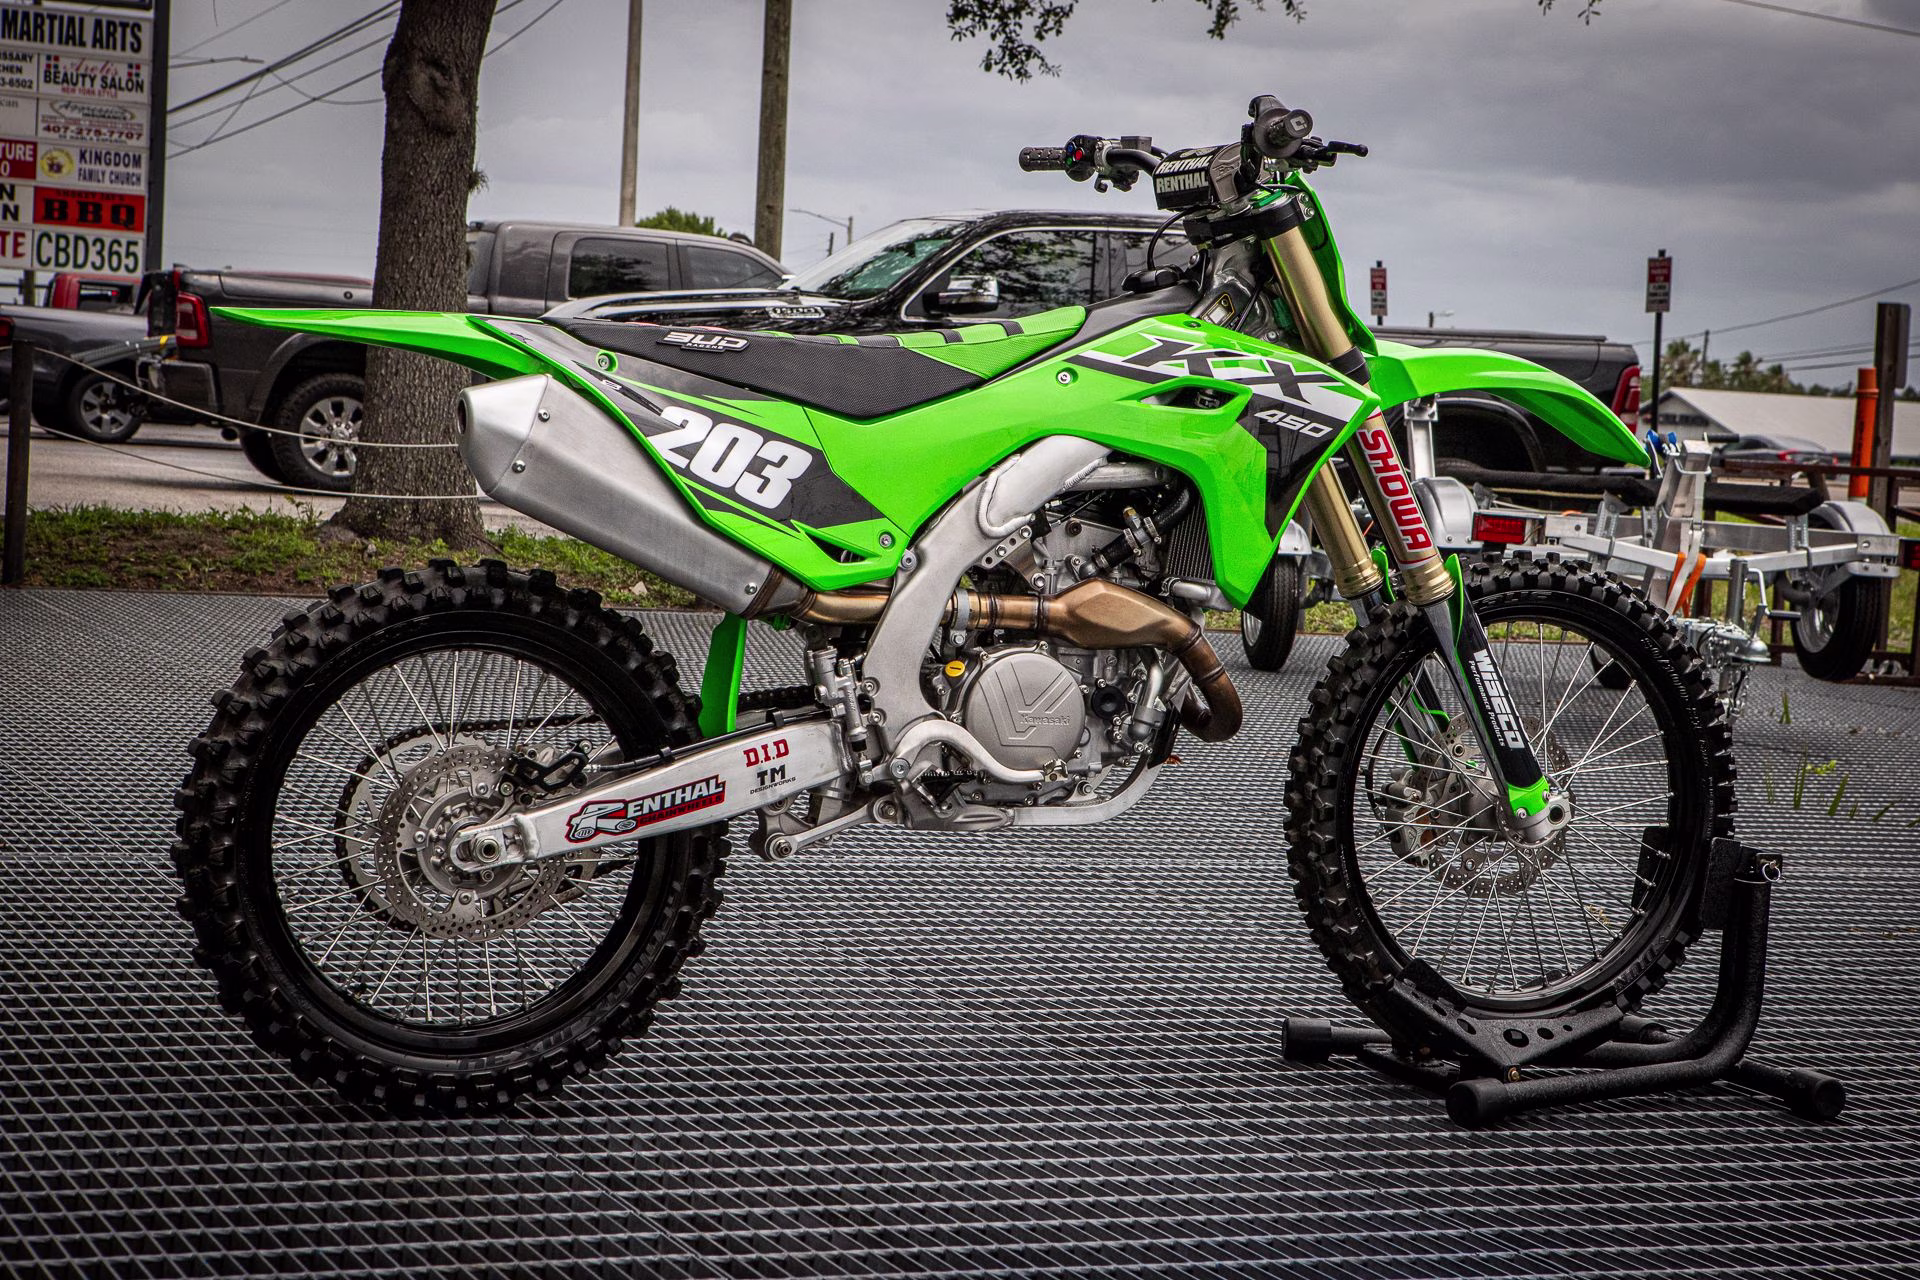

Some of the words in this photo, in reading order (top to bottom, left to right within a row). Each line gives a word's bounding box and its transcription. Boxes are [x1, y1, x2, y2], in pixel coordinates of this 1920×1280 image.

[2, 8, 86, 47] MARTIAL
[92, 18, 142, 53] ARTS
[44, 70, 97, 88] BEAUTY
[100, 76, 144, 93] SALON
[61, 86, 76, 94] NEW
[78, 88, 95, 96] YORK
[97, 89, 118, 98] STYLE
[80, 149, 141, 168] KINGDOM
[1155, 155, 1213, 175] RENTHAL
[78, 168, 105, 184] FAMILY
[109, 170, 141, 186] CHURCH
[1156, 171, 1209, 193] RENTHAL
[0, 230, 25, 258] TE
[36, 231, 139, 273] CBD365
[1254, 408, 1334, 438] 450
[647, 405, 813, 509] 203
[1356, 427, 1433, 553] SHOWA
[1468, 660, 1490, 711] Performance
[1489, 711, 1506, 747] Products
[1020, 713, 1070, 726] Kawasaki
[743, 738, 790, 767] D.I.D
[750, 776, 796, 795] DESIGNWORKS
[757, 764, 786, 787] TM
